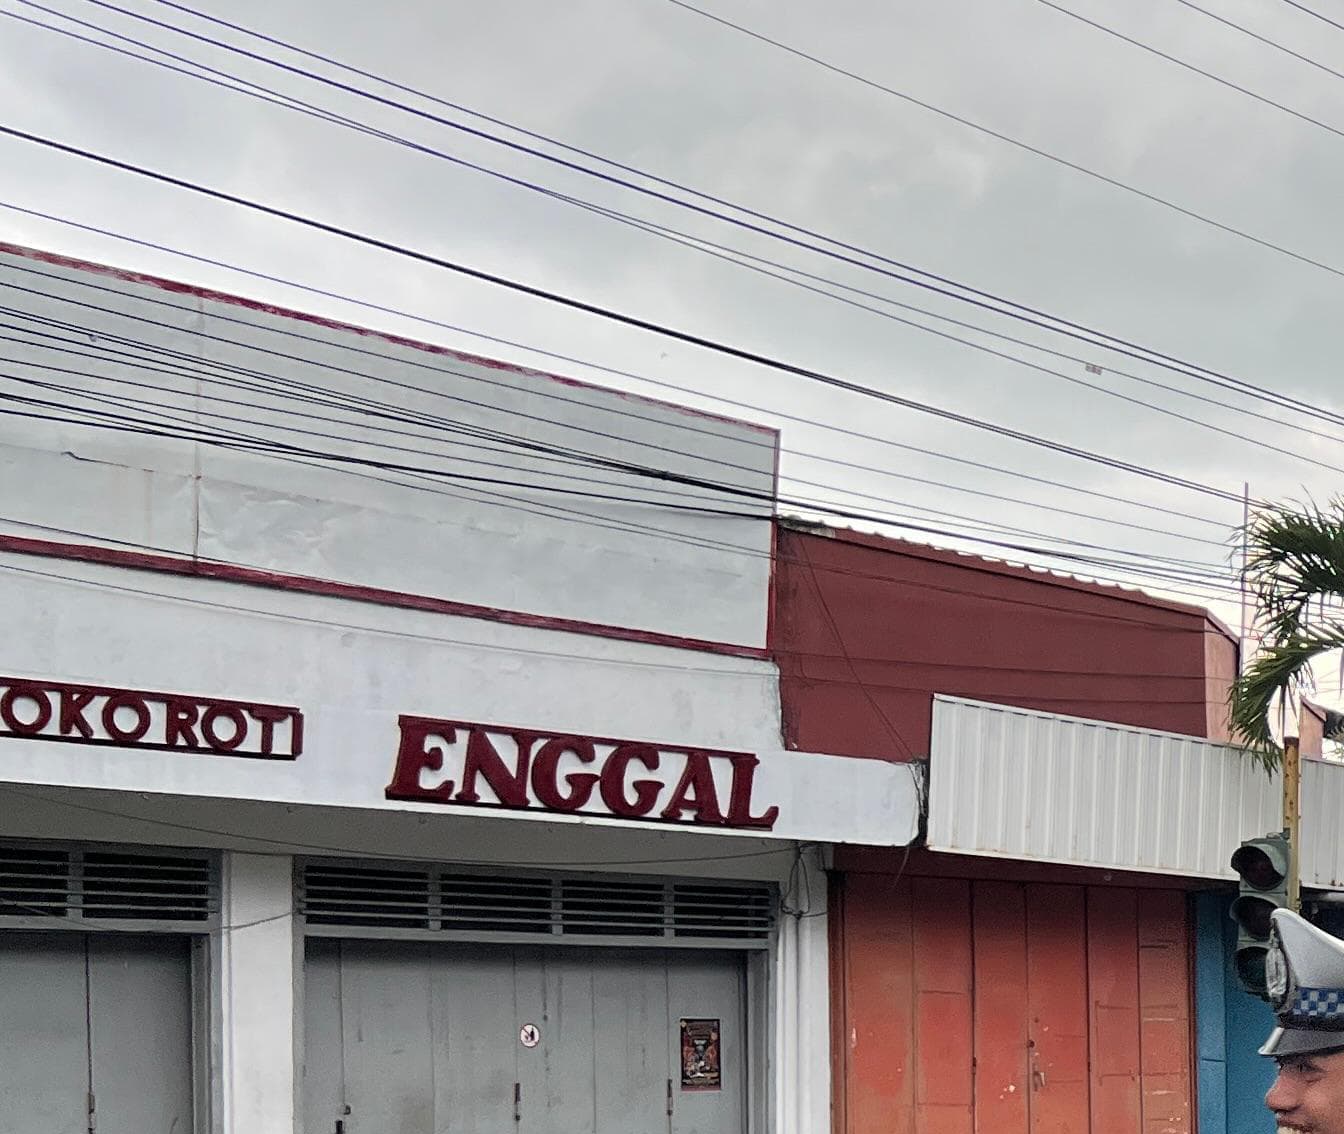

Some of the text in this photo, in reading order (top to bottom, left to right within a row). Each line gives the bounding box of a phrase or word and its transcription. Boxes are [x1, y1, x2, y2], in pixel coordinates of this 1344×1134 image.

[0, 681, 304, 760] OKO ROTI
[385, 715, 779, 831] ENGGAL
